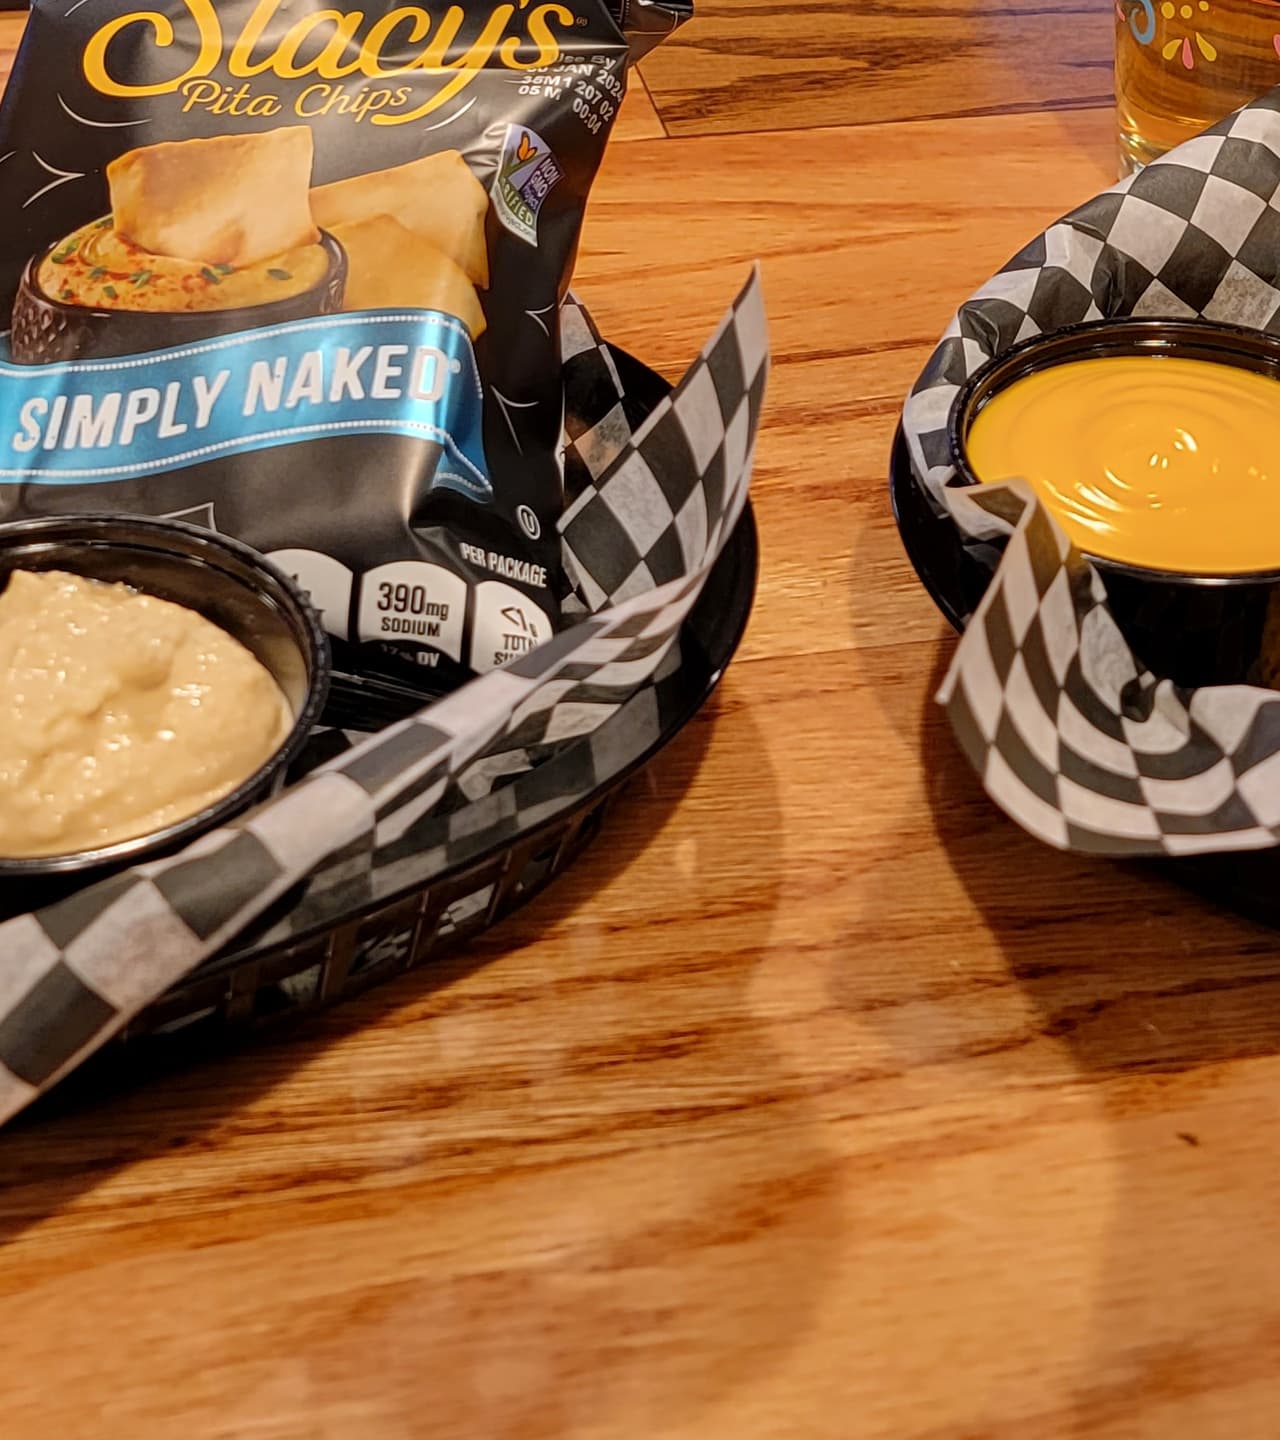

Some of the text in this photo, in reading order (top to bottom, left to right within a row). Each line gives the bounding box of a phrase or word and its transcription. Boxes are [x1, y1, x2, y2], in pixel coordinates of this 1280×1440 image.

[552, 63, 595, 77] JAN
[182, 79, 413, 123] Pita Chips
[530, 171, 549, 198] GMO
[540, 157, 561, 185] NON
[11, 344, 450, 453] SIMPLY NAKED
[459, 541, 549, 589] PER PACKAGE
[380, 615, 442, 639] SODIUM
